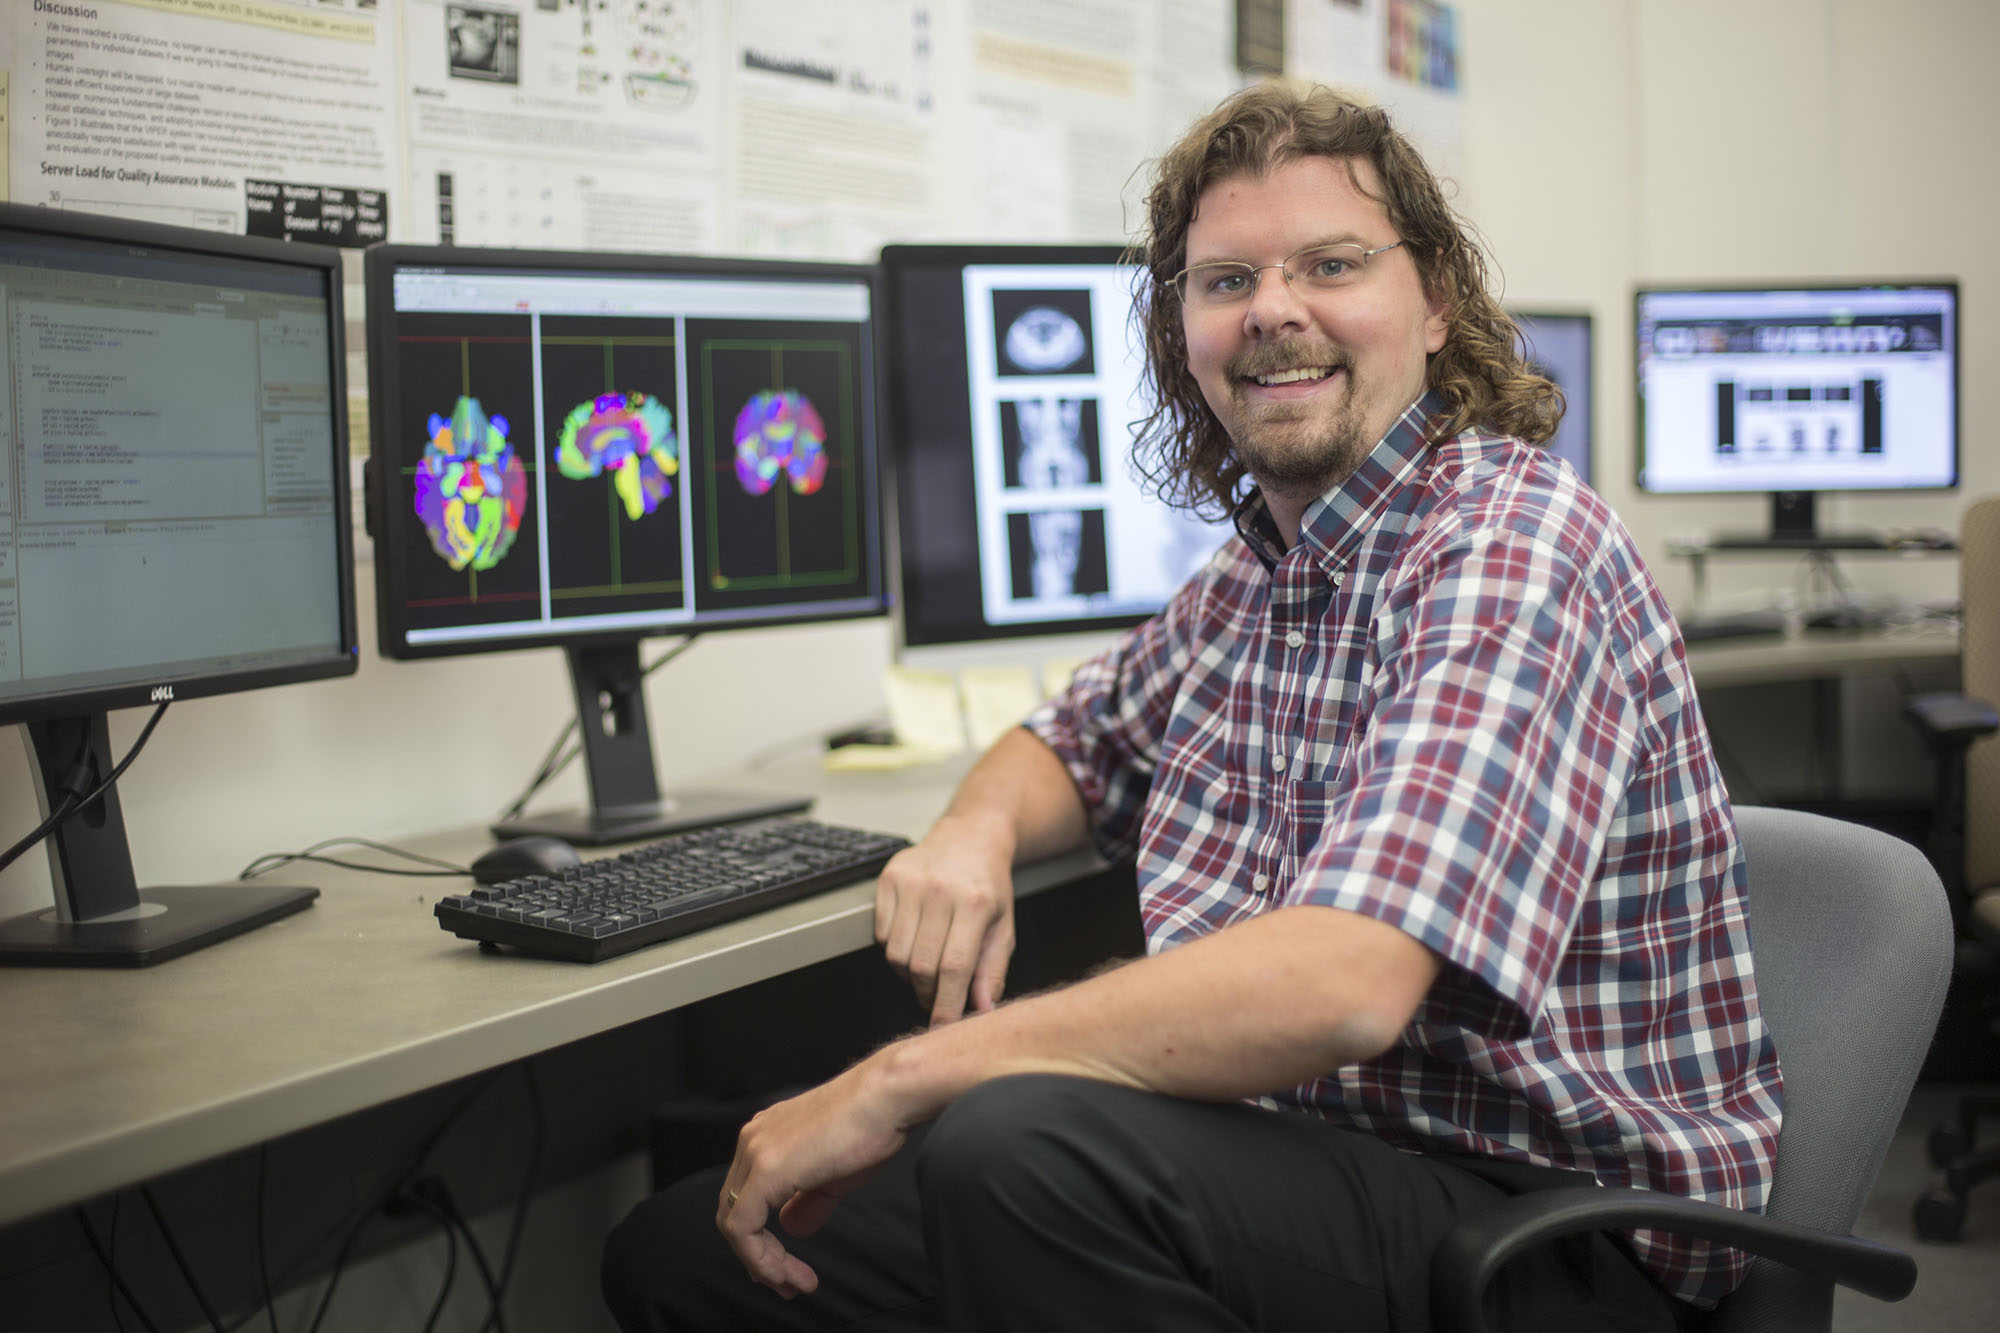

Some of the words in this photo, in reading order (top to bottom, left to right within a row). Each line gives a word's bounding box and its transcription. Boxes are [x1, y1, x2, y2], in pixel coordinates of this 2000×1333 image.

[33, 0, 98, 19] Discussion
[47, 21, 60, 32] We
[61, 24, 80, 35] have
[82, 27, 111, 39] reached
[118, 32, 141, 43] critical
[46, 36, 89, 49] parameters
[90, 41, 101, 50] for
[102, 43, 135, 55] individual
[46, 50, 74, 60] images
[46, 62, 74, 73] Human
[76, 66, 109, 79] oversight
[111, 70, 122, 80] will
[124, 72, 133, 80] be
[45, 77, 72, 87] enable
[75, 80, 103, 92] efficient
[104, 83, 145, 95] supervision
[45, 103, 71, 113] robust
[73, 105, 106, 116] statistical
[84, 94, 120, 105] numerous
[122, 97, 164, 109] fundamental
[46, 115, 71, 127] Figure
[80, 119, 114, 130] illustrates
[116, 122, 130, 131] that
[132, 124, 143, 133] the
[46, 131, 89, 143] anecdotally
[91, 135, 122, 146] reported
[124, 138, 162, 148] satisfaction
[46, 144, 61, 153] and
[62, 145, 100, 155] evaluation
[103, 147, 110, 156] of
[111, 149, 123, 157] the
[125, 151, 158, 161] proposed
[160, 154, 182, 165] quality
[41, 161, 74, 176] Server
[75, 164, 99, 179] Load
[101, 166, 116, 180] for
[117, 167, 151, 186] Quality
[153, 171, 199, 186] Assurance
[49, 190, 60, 202] 30
[282, 185, 319, 201] Number
[151, 685, 175, 701] DELL
